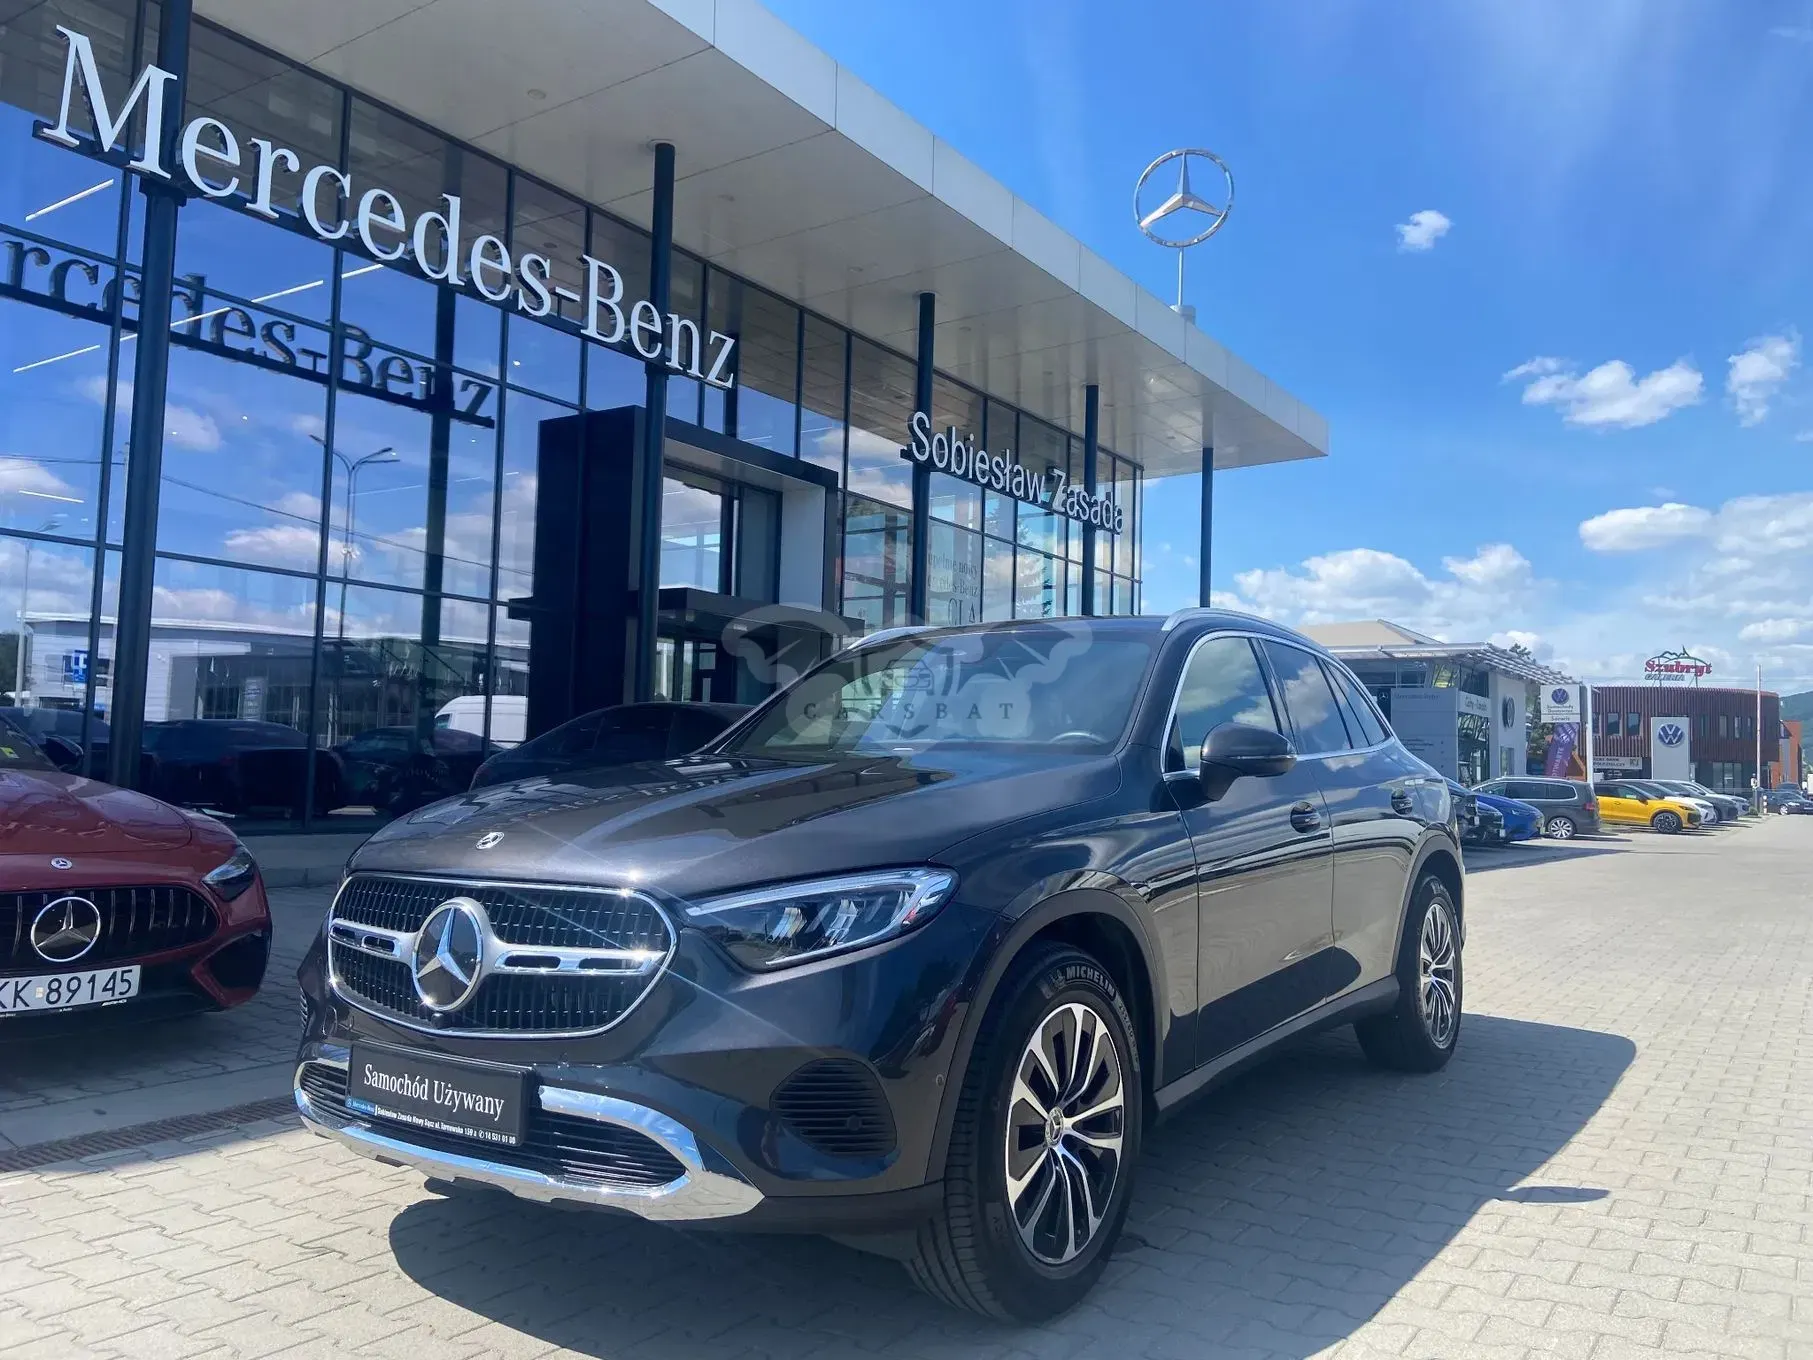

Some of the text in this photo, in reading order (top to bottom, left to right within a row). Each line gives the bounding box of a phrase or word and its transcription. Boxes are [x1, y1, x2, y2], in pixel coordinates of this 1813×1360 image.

[44, 24, 738, 391] Mercedes-Benz
[910, 411, 1125, 534] Sobiesław Zasada
[1645, 659, 1713, 677] Szubryt
[45, 968, 134, 1005] 89145
[1066, 965, 1115, 998] MICHELIN
[363, 1063, 505, 1121] Samochód Używany
